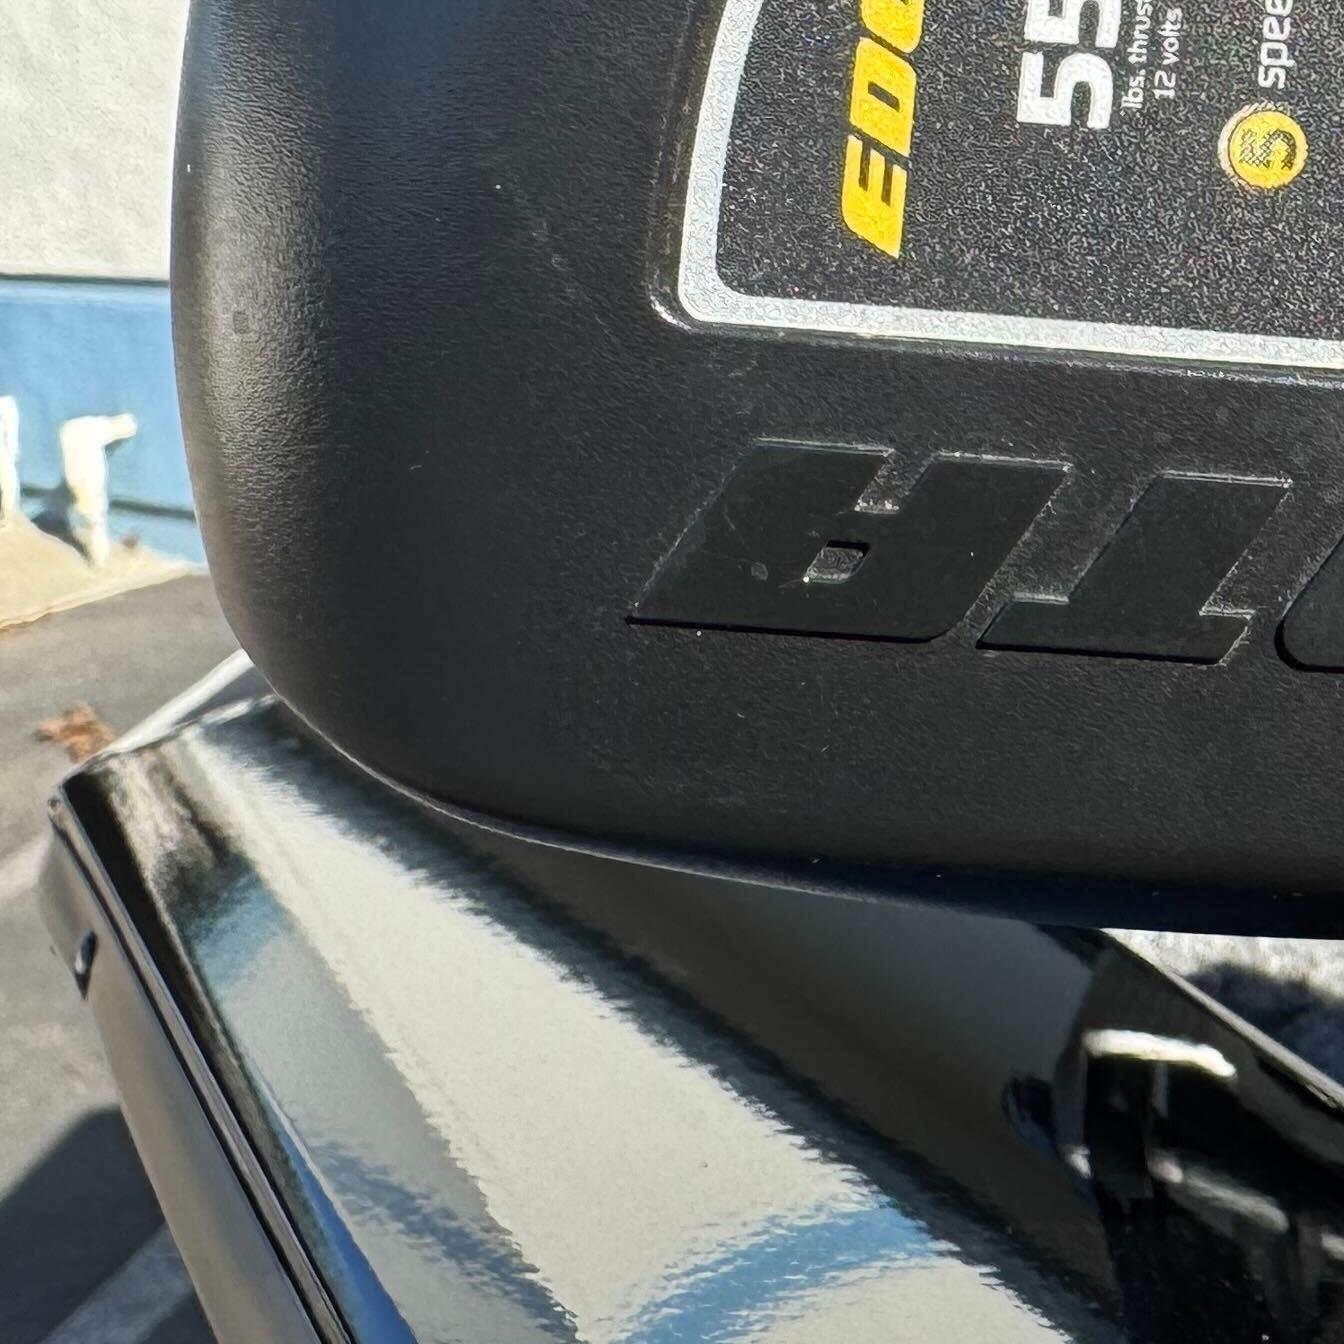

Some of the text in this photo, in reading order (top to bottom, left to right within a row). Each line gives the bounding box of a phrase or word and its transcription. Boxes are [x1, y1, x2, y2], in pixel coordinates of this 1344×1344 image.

[1152, 6, 1183, 100] 12 volts
[1119, 67, 1146, 111] lbs.
[1237, 127, 1295, 172] 5
